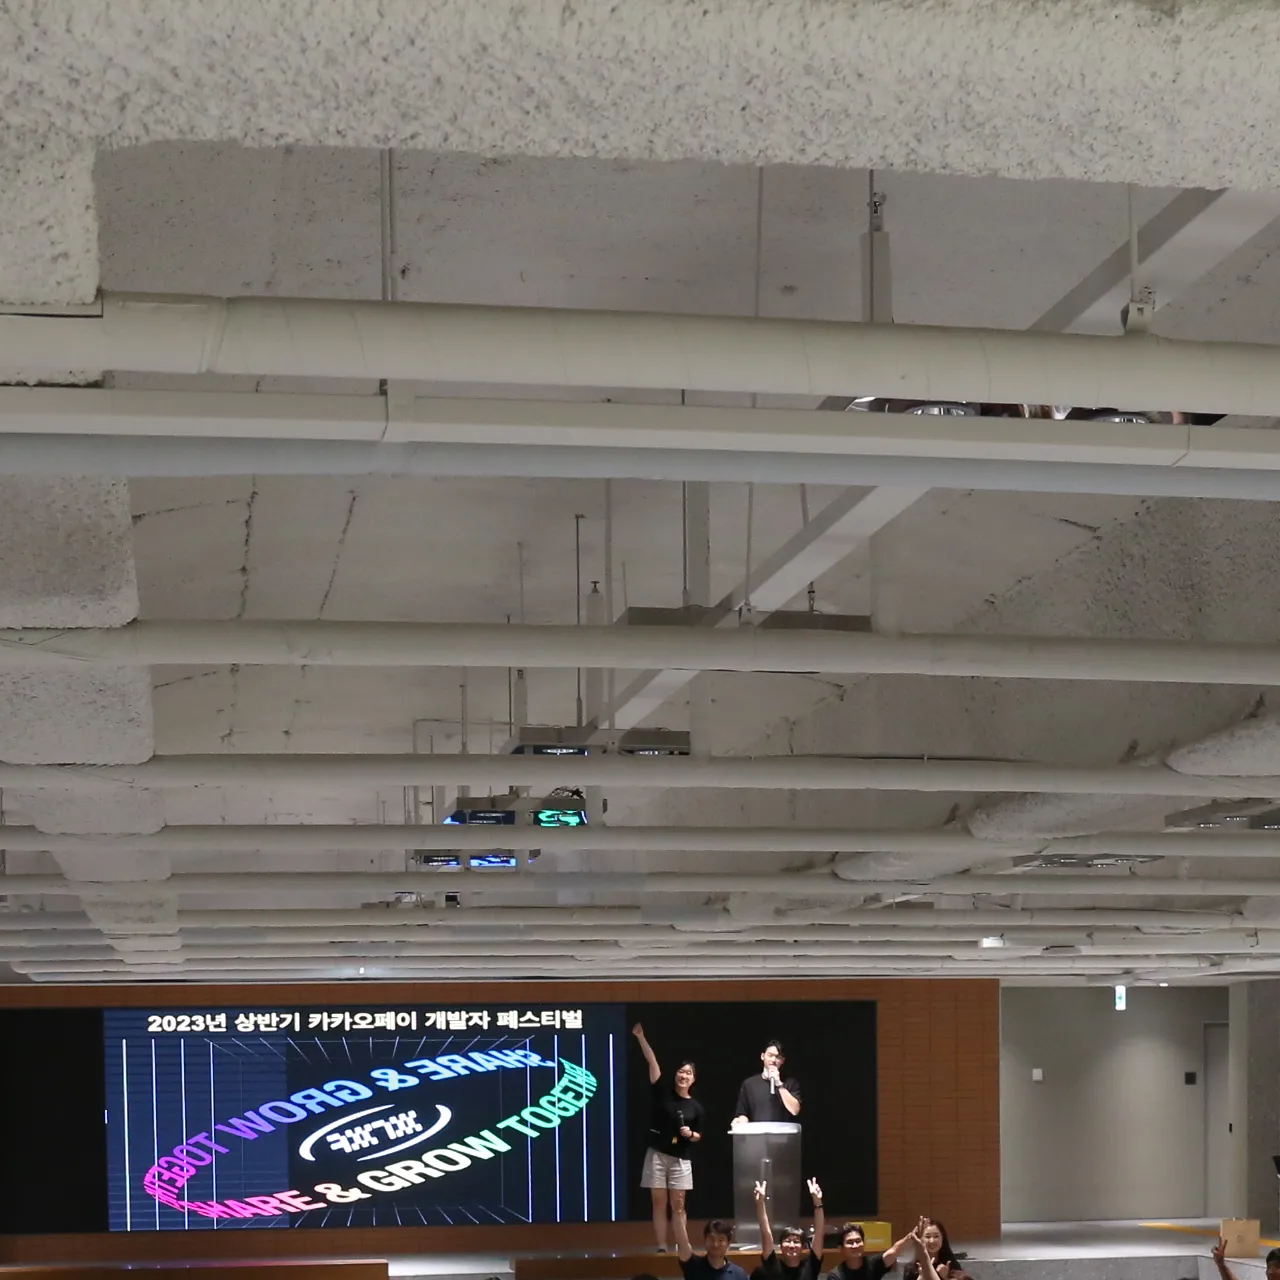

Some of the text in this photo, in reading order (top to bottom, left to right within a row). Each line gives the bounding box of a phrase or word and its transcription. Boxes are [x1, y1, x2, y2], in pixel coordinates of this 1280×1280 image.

[147, 1010, 584, 1032] 2023년 상반기 카카오페이 개발자 페스티벌
[179, 1188, 328, 1219] SHARE
[313, 1182, 372, 1204] &
[356, 1129, 513, 1194] GROW
